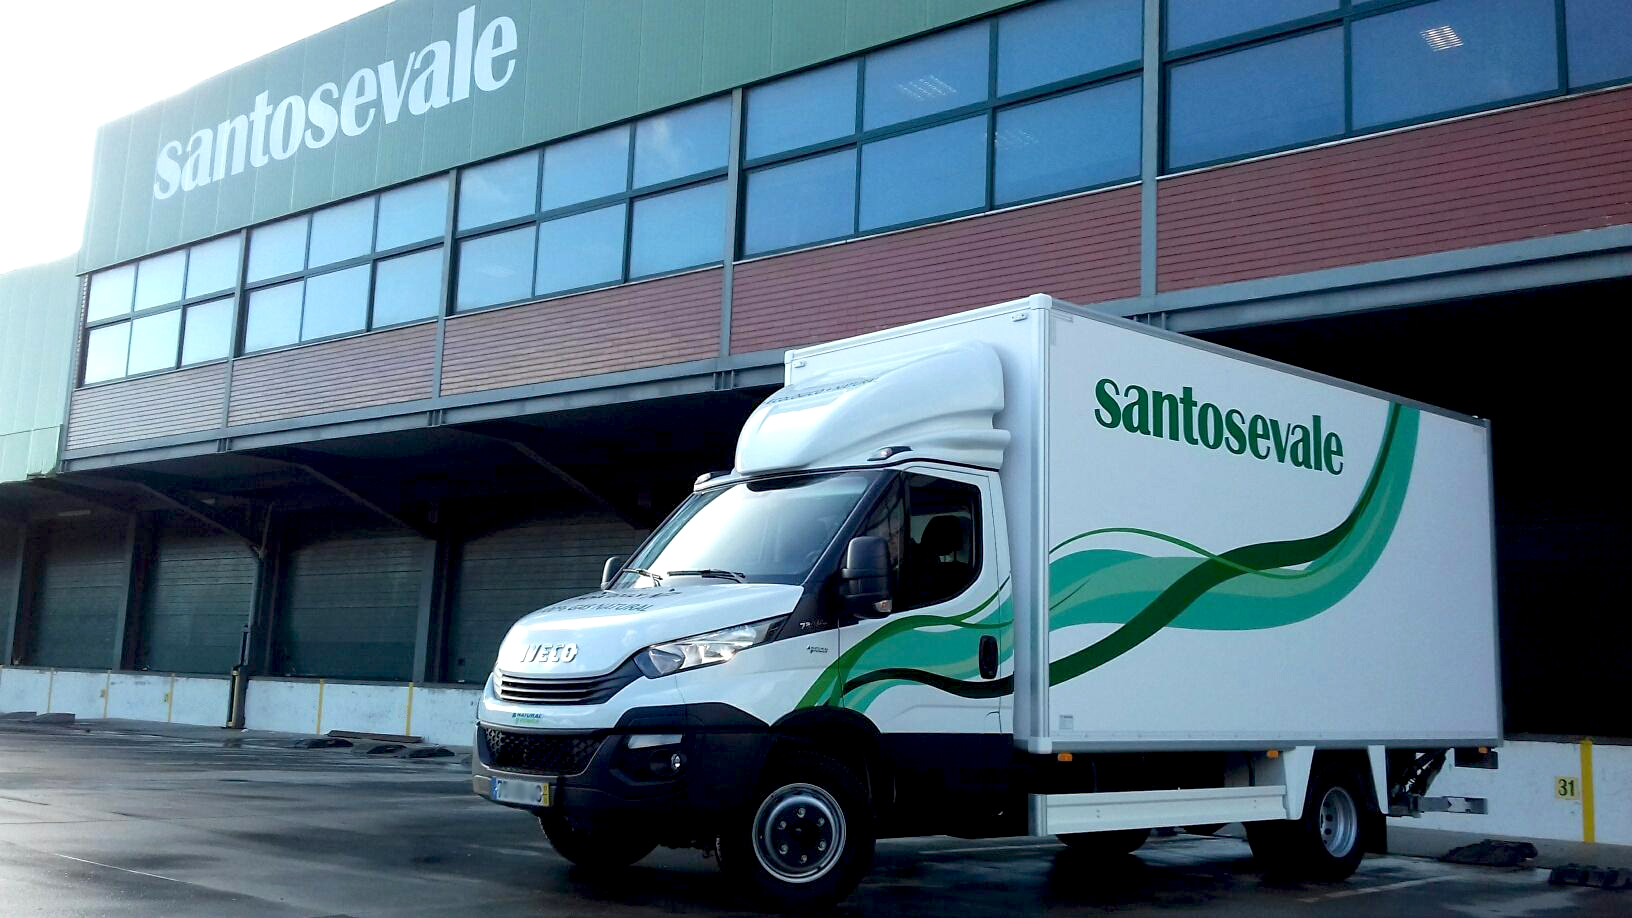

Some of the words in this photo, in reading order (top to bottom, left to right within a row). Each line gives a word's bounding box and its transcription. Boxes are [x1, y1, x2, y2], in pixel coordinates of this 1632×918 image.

[153, 5, 518, 200] santosevale
[1094, 378, 1343, 475] santosevale
[520, 643, 579, 663] IVECO
[1558, 778, 1575, 797] 31
